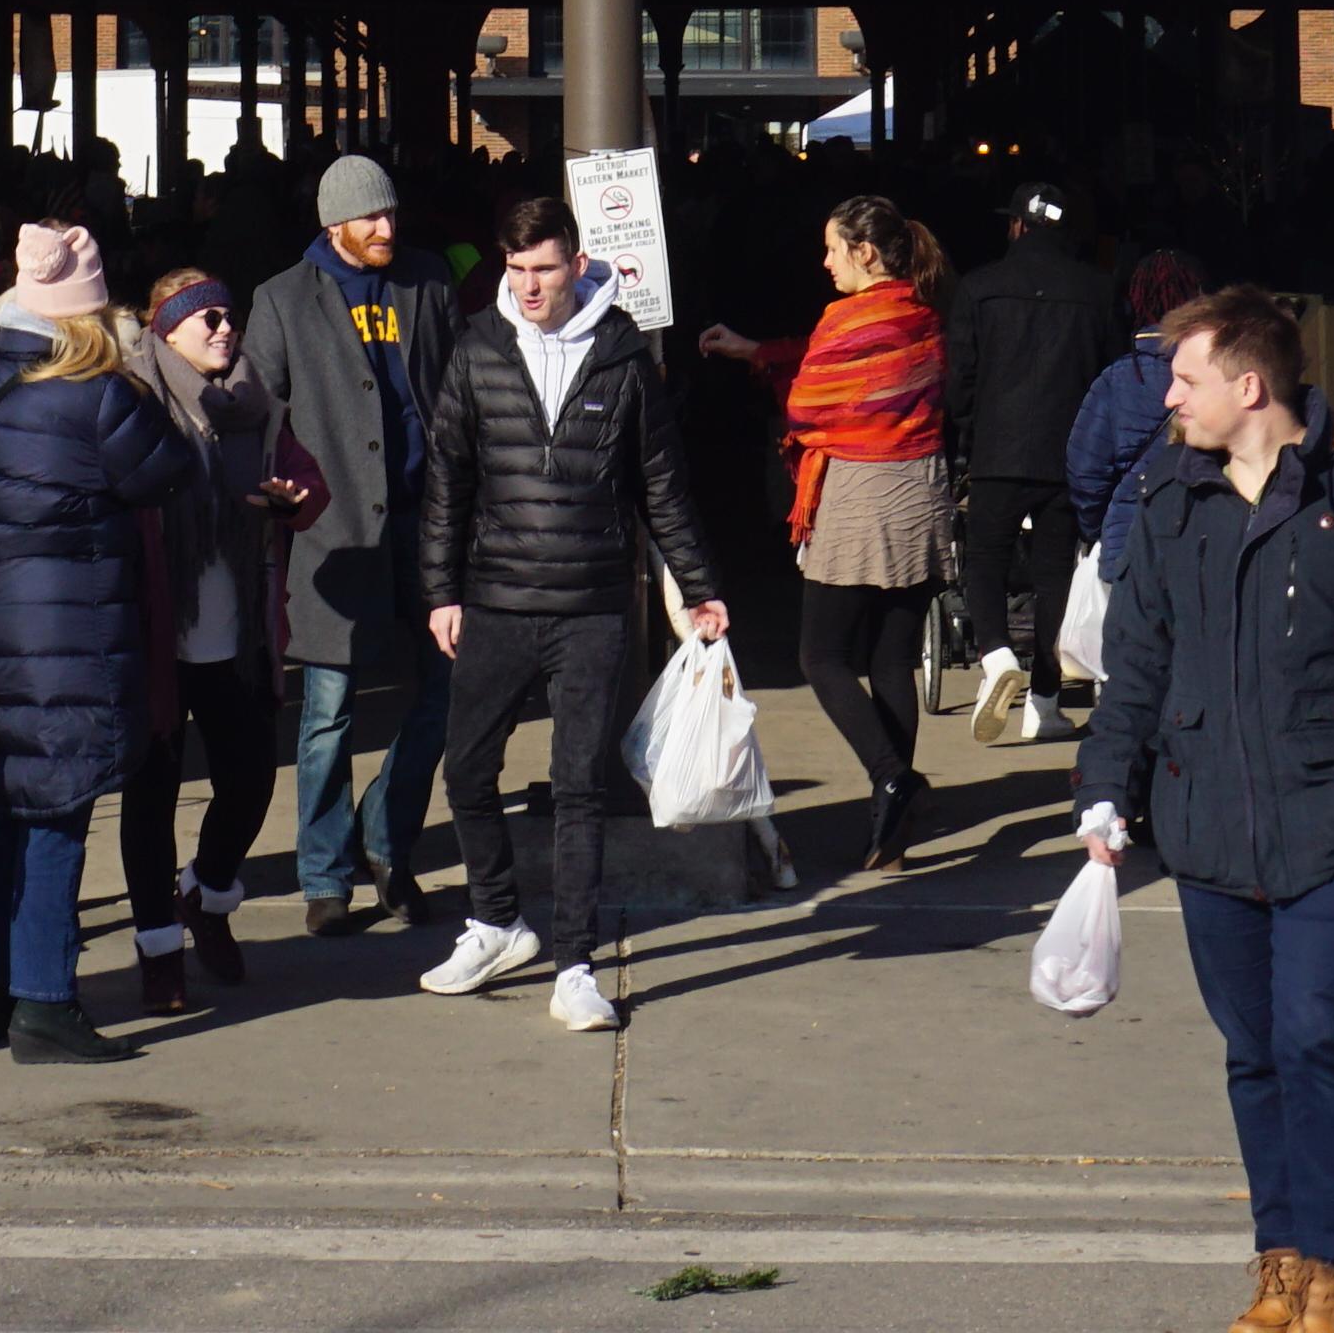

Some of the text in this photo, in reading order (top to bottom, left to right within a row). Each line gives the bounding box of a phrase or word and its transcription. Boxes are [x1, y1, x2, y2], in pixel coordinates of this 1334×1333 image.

[595, 160, 628, 172] DETROIT
[577, 173, 613, 186] EASTERN
[590, 218, 651, 235] NO SMOKING
[588, 228, 656, 247] UNDER SHEDS
[626, 288, 651, 299] DOGS
